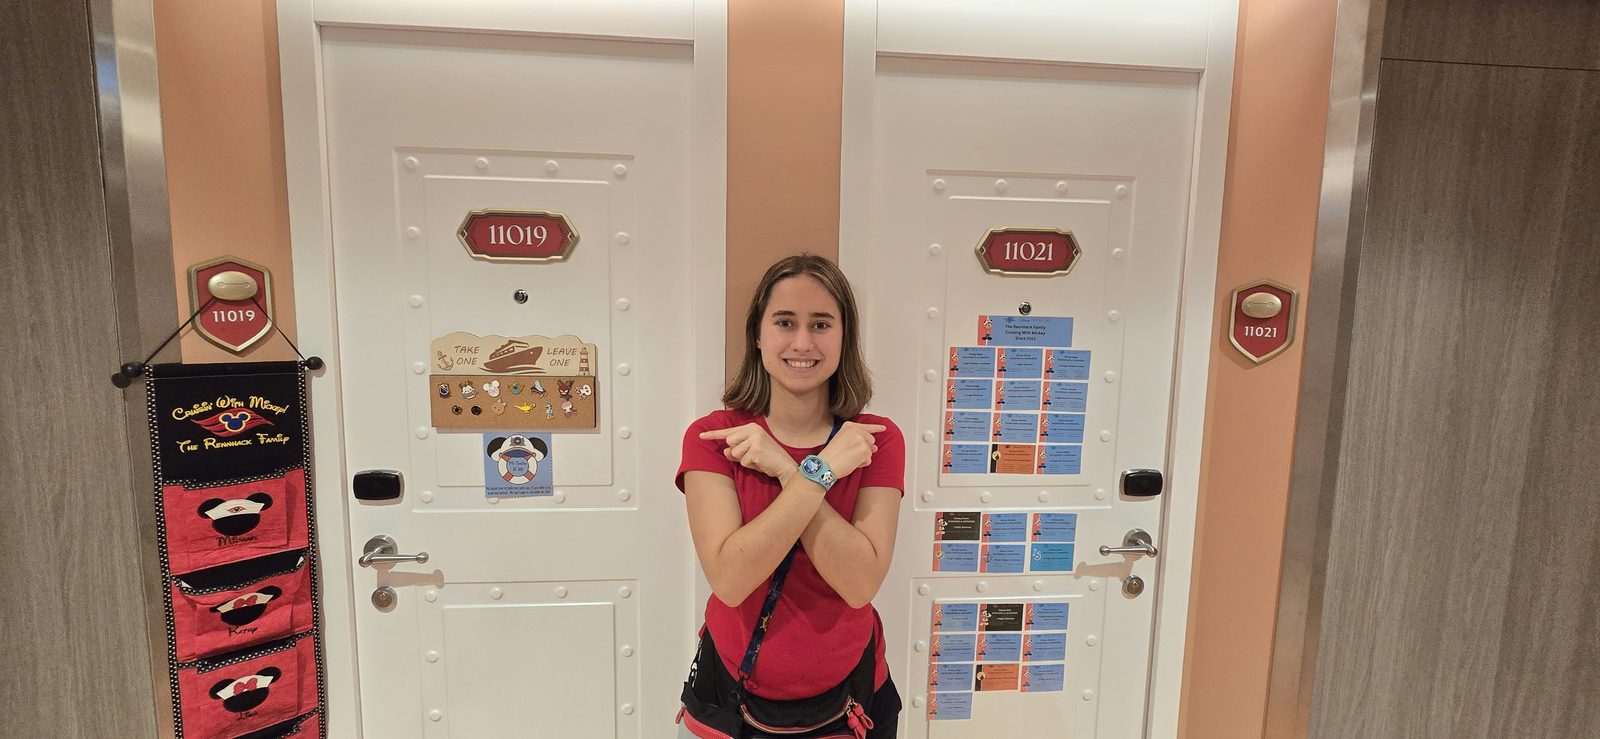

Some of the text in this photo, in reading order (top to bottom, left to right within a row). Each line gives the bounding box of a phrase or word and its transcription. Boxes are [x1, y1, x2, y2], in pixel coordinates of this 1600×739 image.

[489, 225, 548, 248] 11019
[1004, 241, 1054, 261] 11021
[212, 310, 255, 323] 11019
[1244, 326, 1277, 338] 11021
[454, 345, 480, 354] TAKE
[547, 347, 579, 356] LEAVE
[456, 357, 478, 365] ONE
[550, 358, 571, 367] ONE
[216, 395, 245, 408] With
[176, 440, 199, 453] The
[256, 433, 290, 445] Family
